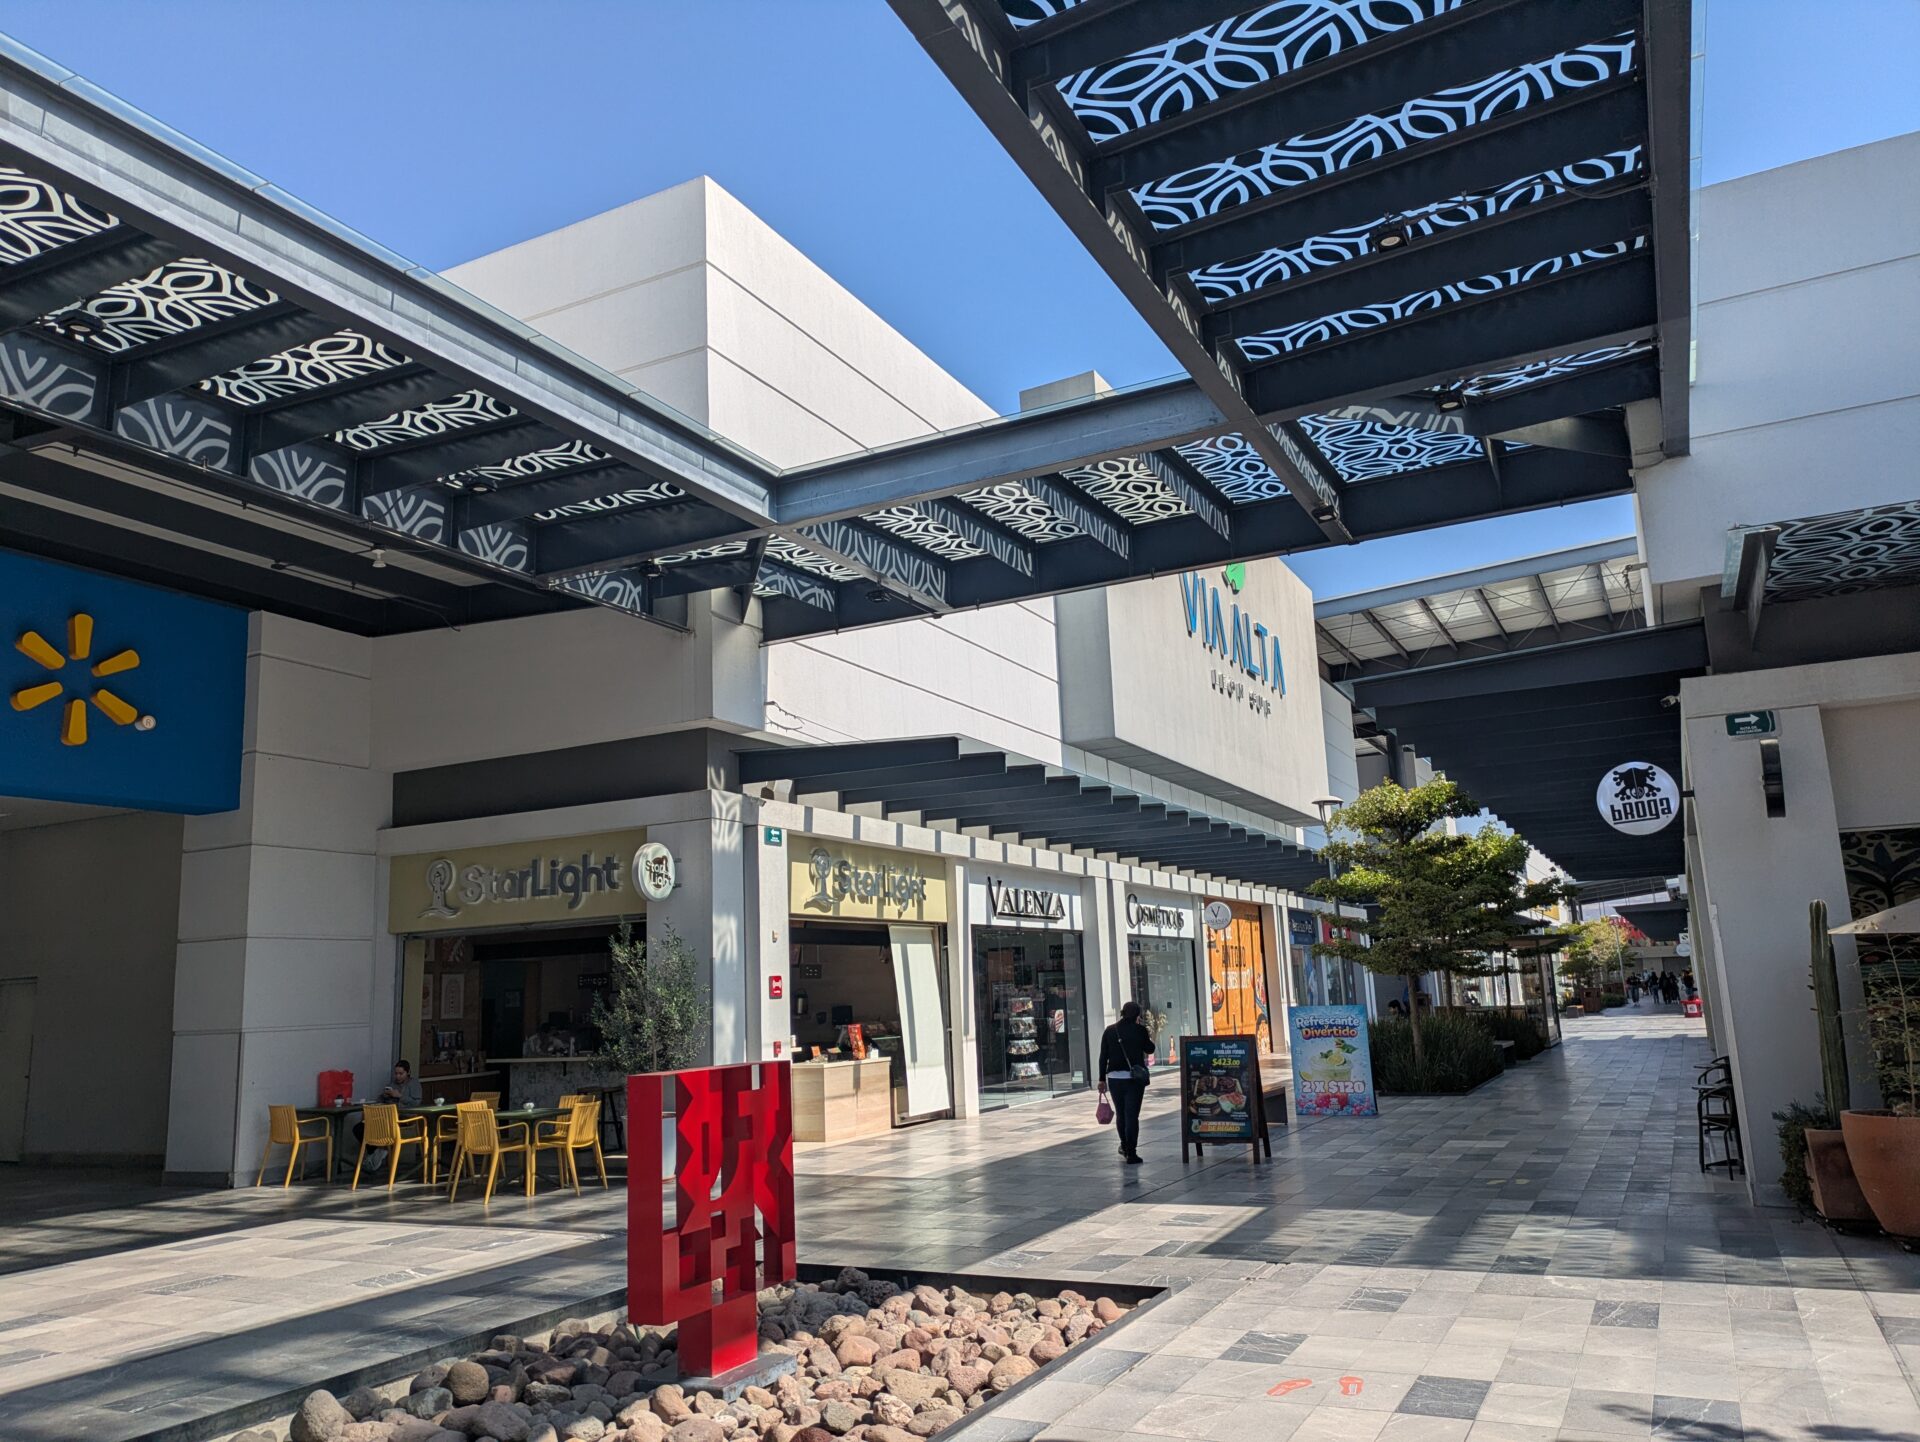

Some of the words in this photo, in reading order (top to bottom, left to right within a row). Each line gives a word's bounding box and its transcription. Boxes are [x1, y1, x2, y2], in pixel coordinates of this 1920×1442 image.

[1230, 604, 1286, 699] ALTA
[645, 860, 665, 873] Star
[459, 854, 620, 910] StarLight
[651, 872, 672, 888] Light
[836, 860, 927, 912] StarLight
[987, 876, 1066, 917] VALENZA
[1295, 1016, 1360, 1028] Refrescante
[1302, 1026, 1358, 1039] Divertido
[1212, 1057, 1241, 1067] $423.00
[1303, 1081, 1312, 1093] 2
[1314, 1081, 1325, 1093] X
[1328, 1081, 1366, 1094] $120
